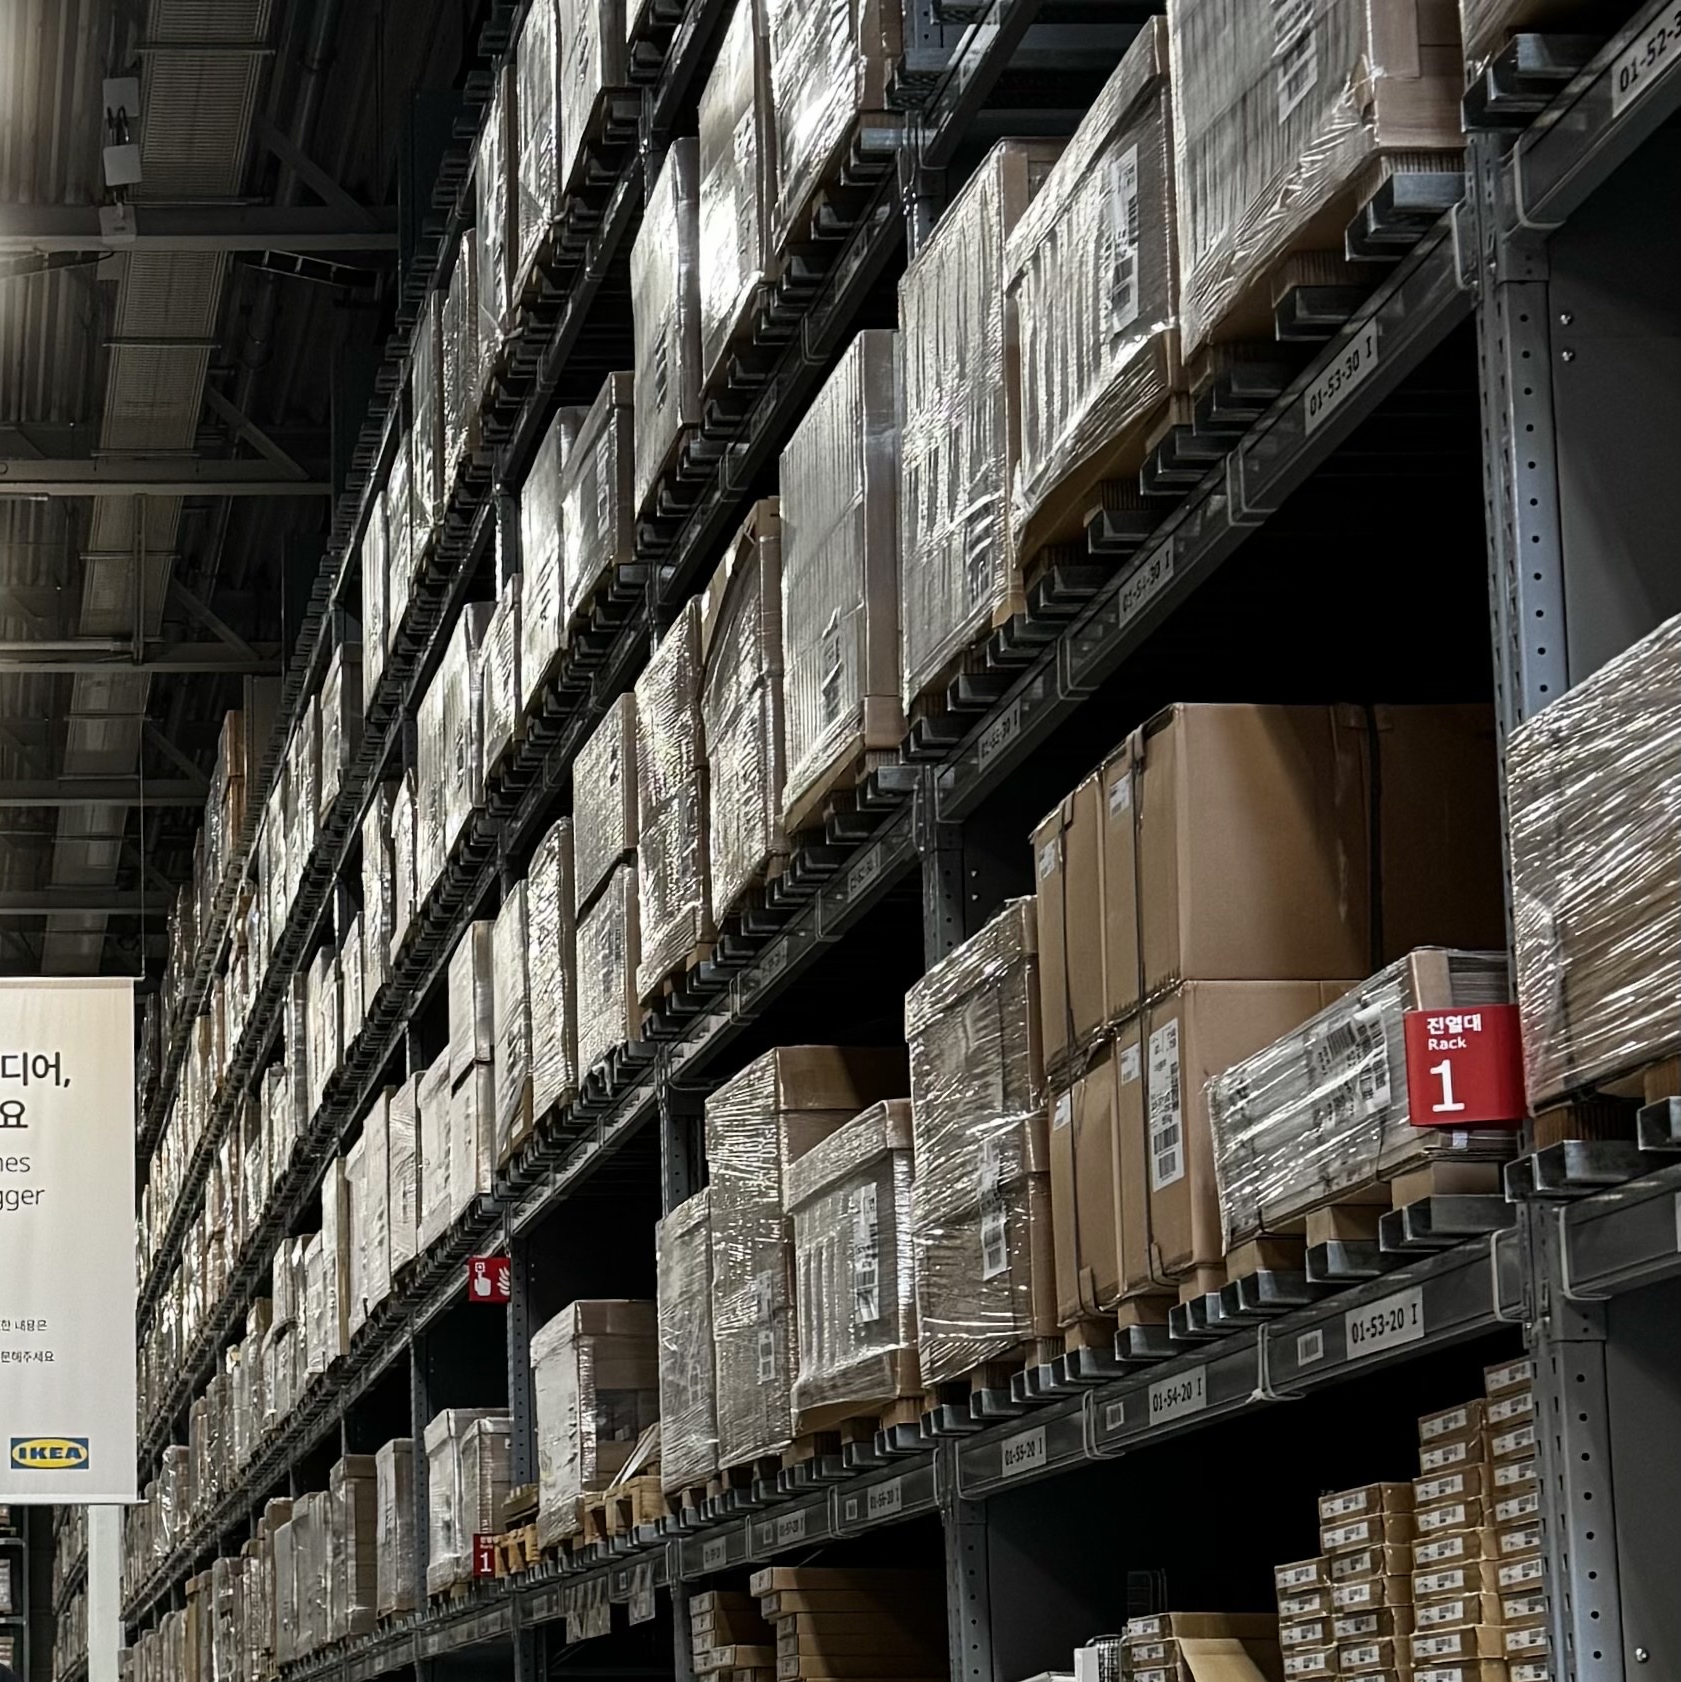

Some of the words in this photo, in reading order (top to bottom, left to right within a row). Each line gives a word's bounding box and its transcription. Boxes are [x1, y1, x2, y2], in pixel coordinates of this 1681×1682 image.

[1309, 350, 1360, 415] 01-53-30
[1427, 1013, 1482, 1035] 진열대
[1428, 1036, 1467, 1050] Rack
[1430, 1059, 1465, 1112] 1
[14, 1319, 48, 1332] 내용은
[1351, 1310, 1405, 1345] 01-53-20
[1152, 1382, 1193, 1413] 01-54-20
[18, 1445, 83, 1461] IKEA
[480, 1552, 492, 1572] 1
